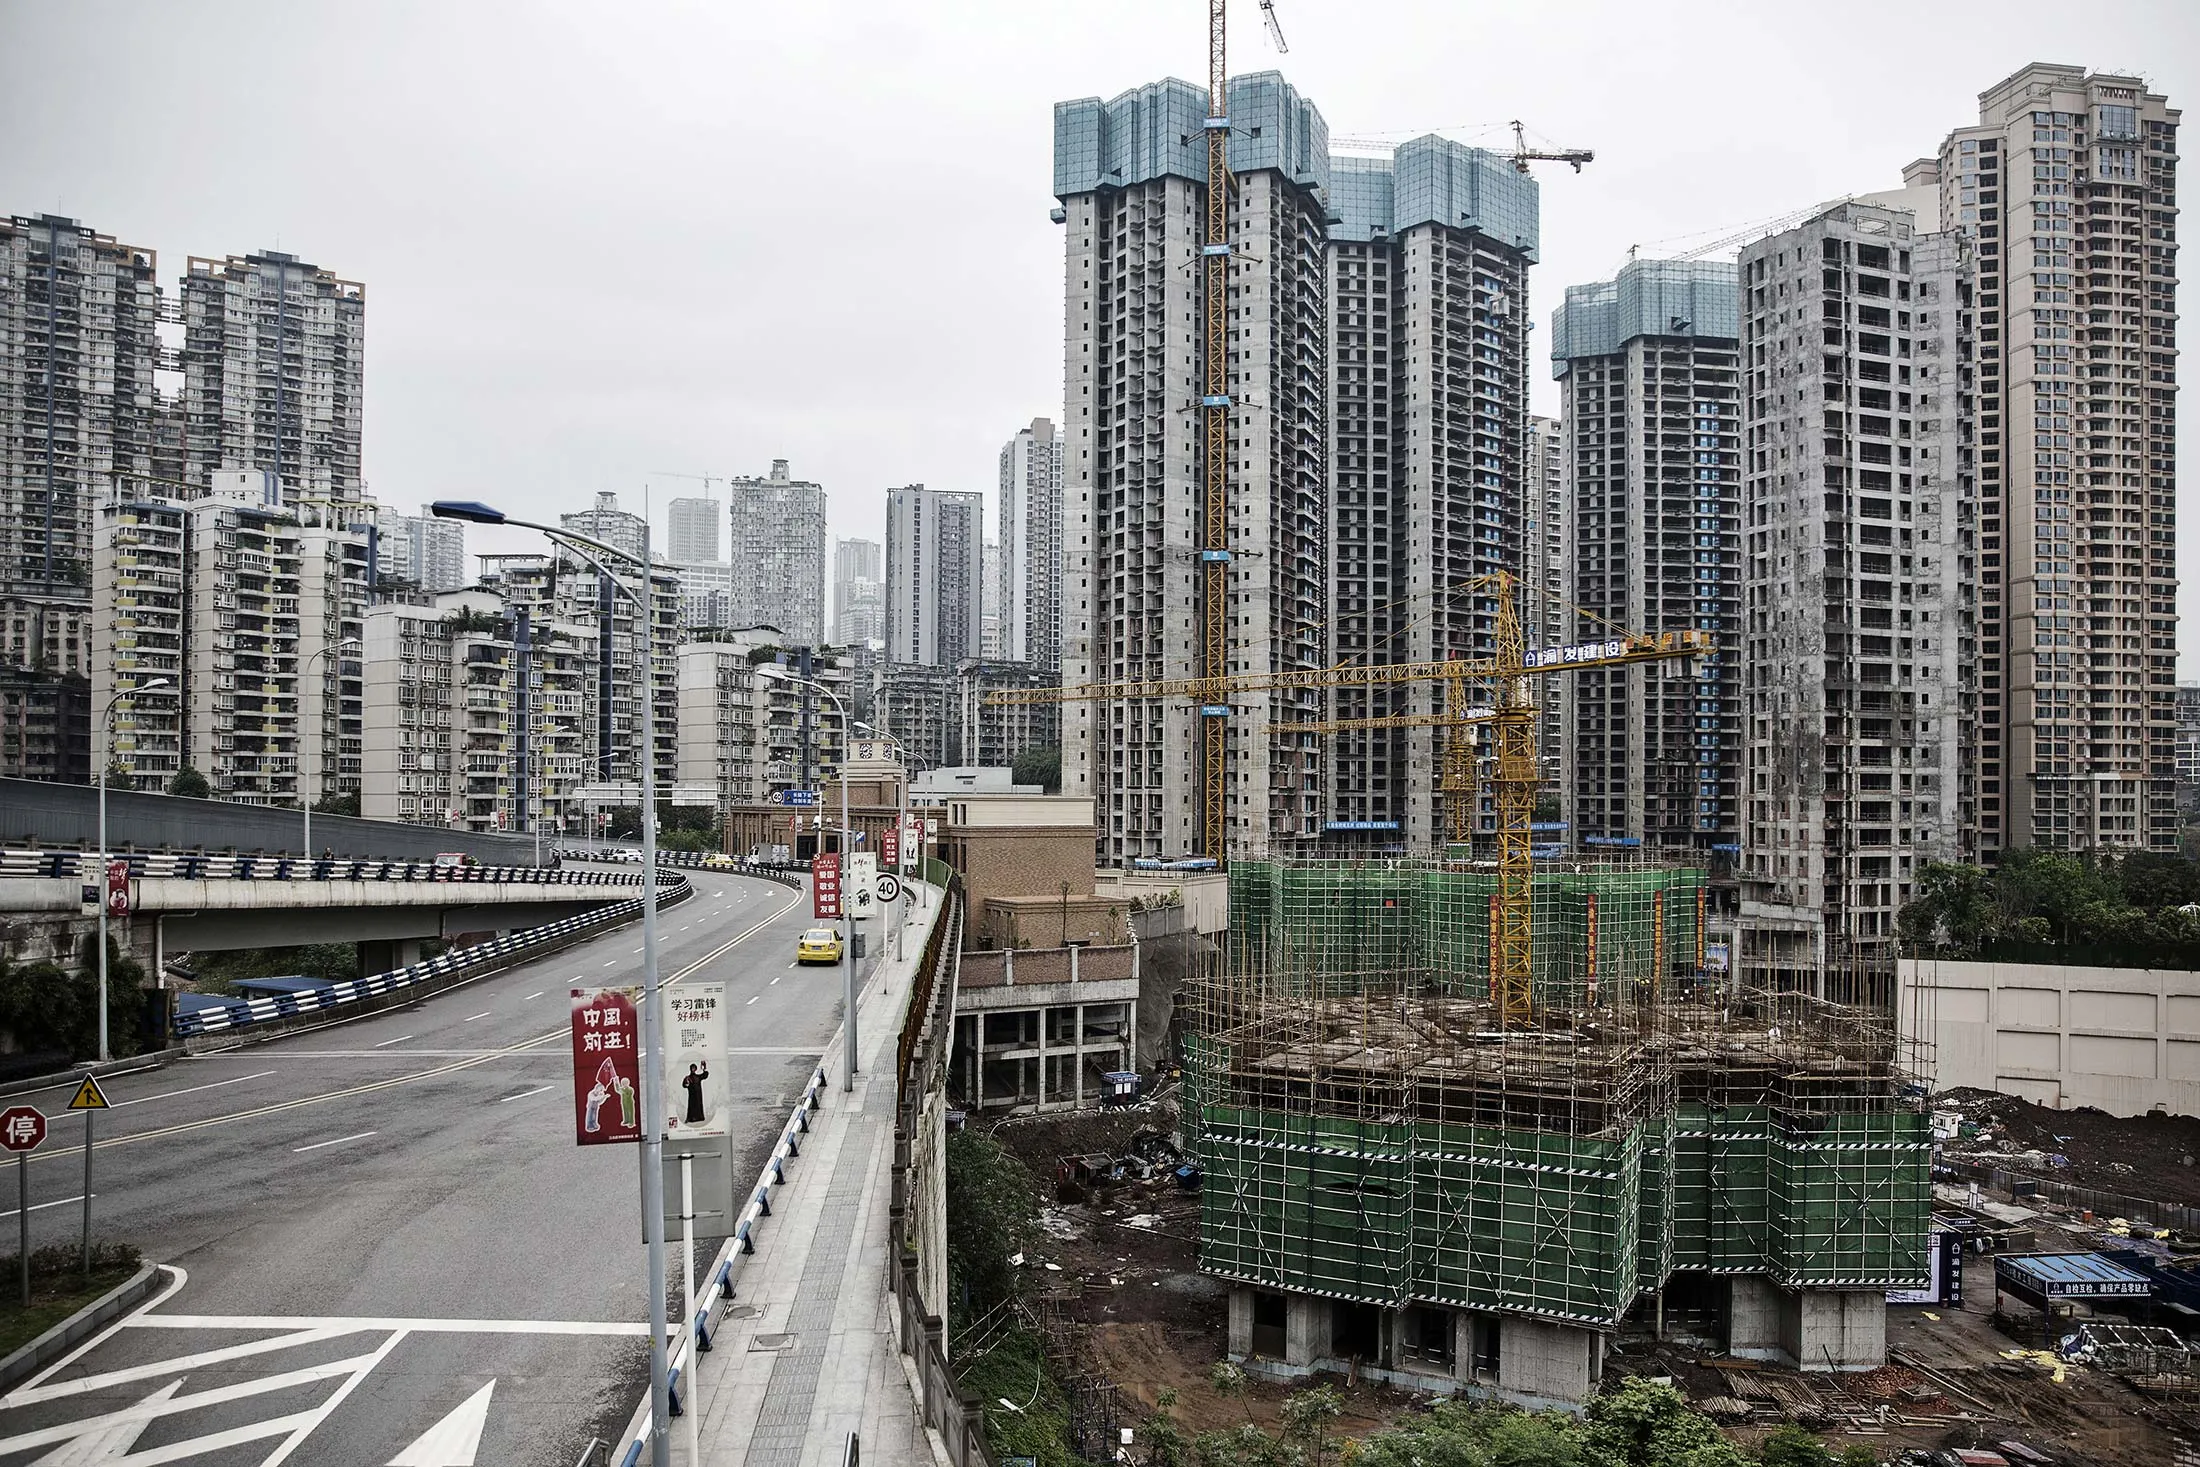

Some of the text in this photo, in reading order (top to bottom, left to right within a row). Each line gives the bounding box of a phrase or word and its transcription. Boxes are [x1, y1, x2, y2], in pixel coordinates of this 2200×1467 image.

[878, 882, 894, 895] 40
[671, 998, 717, 1011] 学习雷锋
[677, 1011, 712, 1022] 好榜样
[6, 1115, 37, 1144] 停
